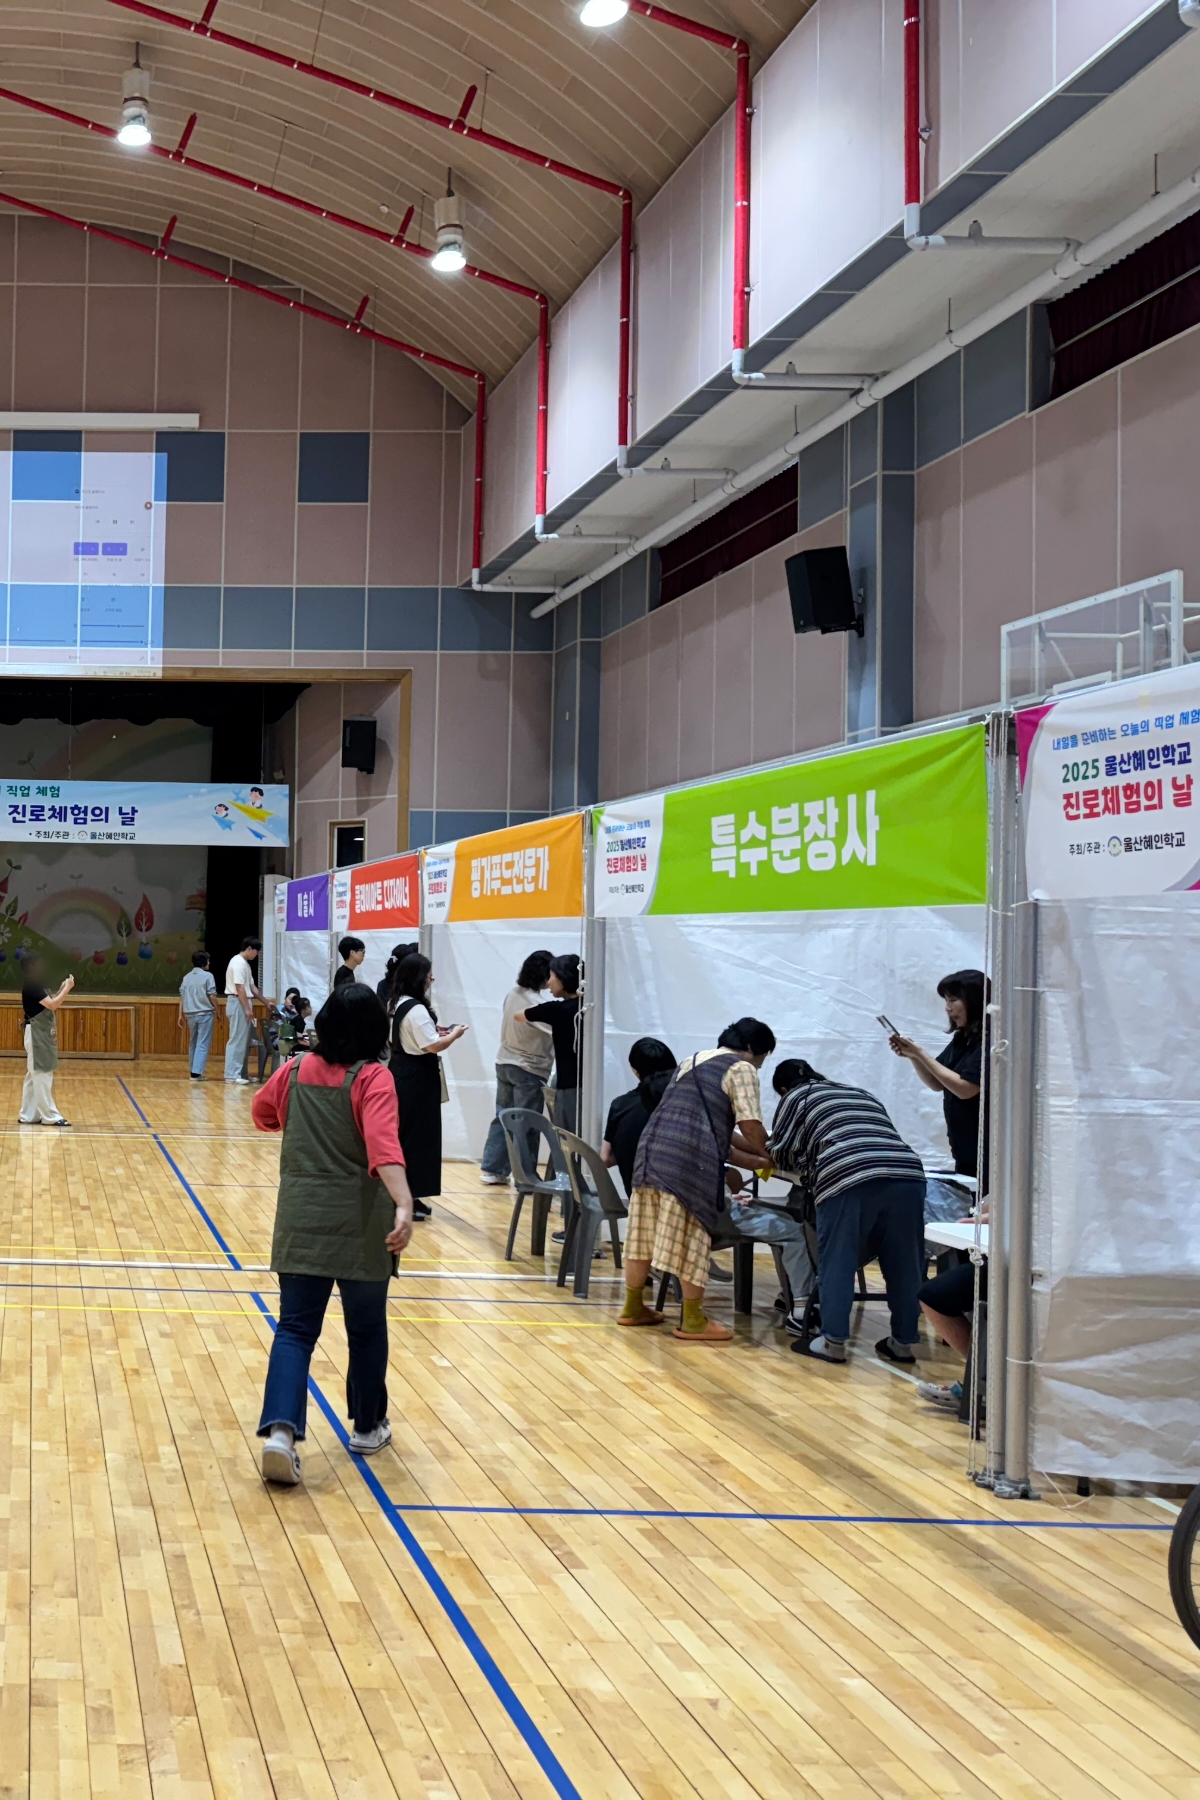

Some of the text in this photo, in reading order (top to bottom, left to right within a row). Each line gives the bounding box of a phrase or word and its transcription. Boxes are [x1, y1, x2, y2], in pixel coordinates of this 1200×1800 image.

[1052, 734, 1079, 751] 내일을
[1081, 727, 1117, 746] 준비하는
[1120, 720, 1150, 738] 오늘의
[1154, 715, 1175, 731] 직업
[1062, 742, 1192, 784] 2025 울산혜인학교
[6, 785, 30, 798] 직업
[35, 785, 61, 798] 체험
[1062, 774, 1194, 822] 진로체험의 날
[8, 803, 109, 824] 진로체험의
[118, 805, 138, 826] 날
[35, 830, 70, 840] 주최/주관
[90, 831, 136, 841] 울산혜인학교
[710, 790, 880, 878] 특수분장사
[1069, 841, 1101, 856] 주최/주관
[1123, 832, 1186, 853] 울산혜인학교
[471, 845, 550, 898] 핑거푸드전문가
[384, 876, 410, 909] 디자이너
